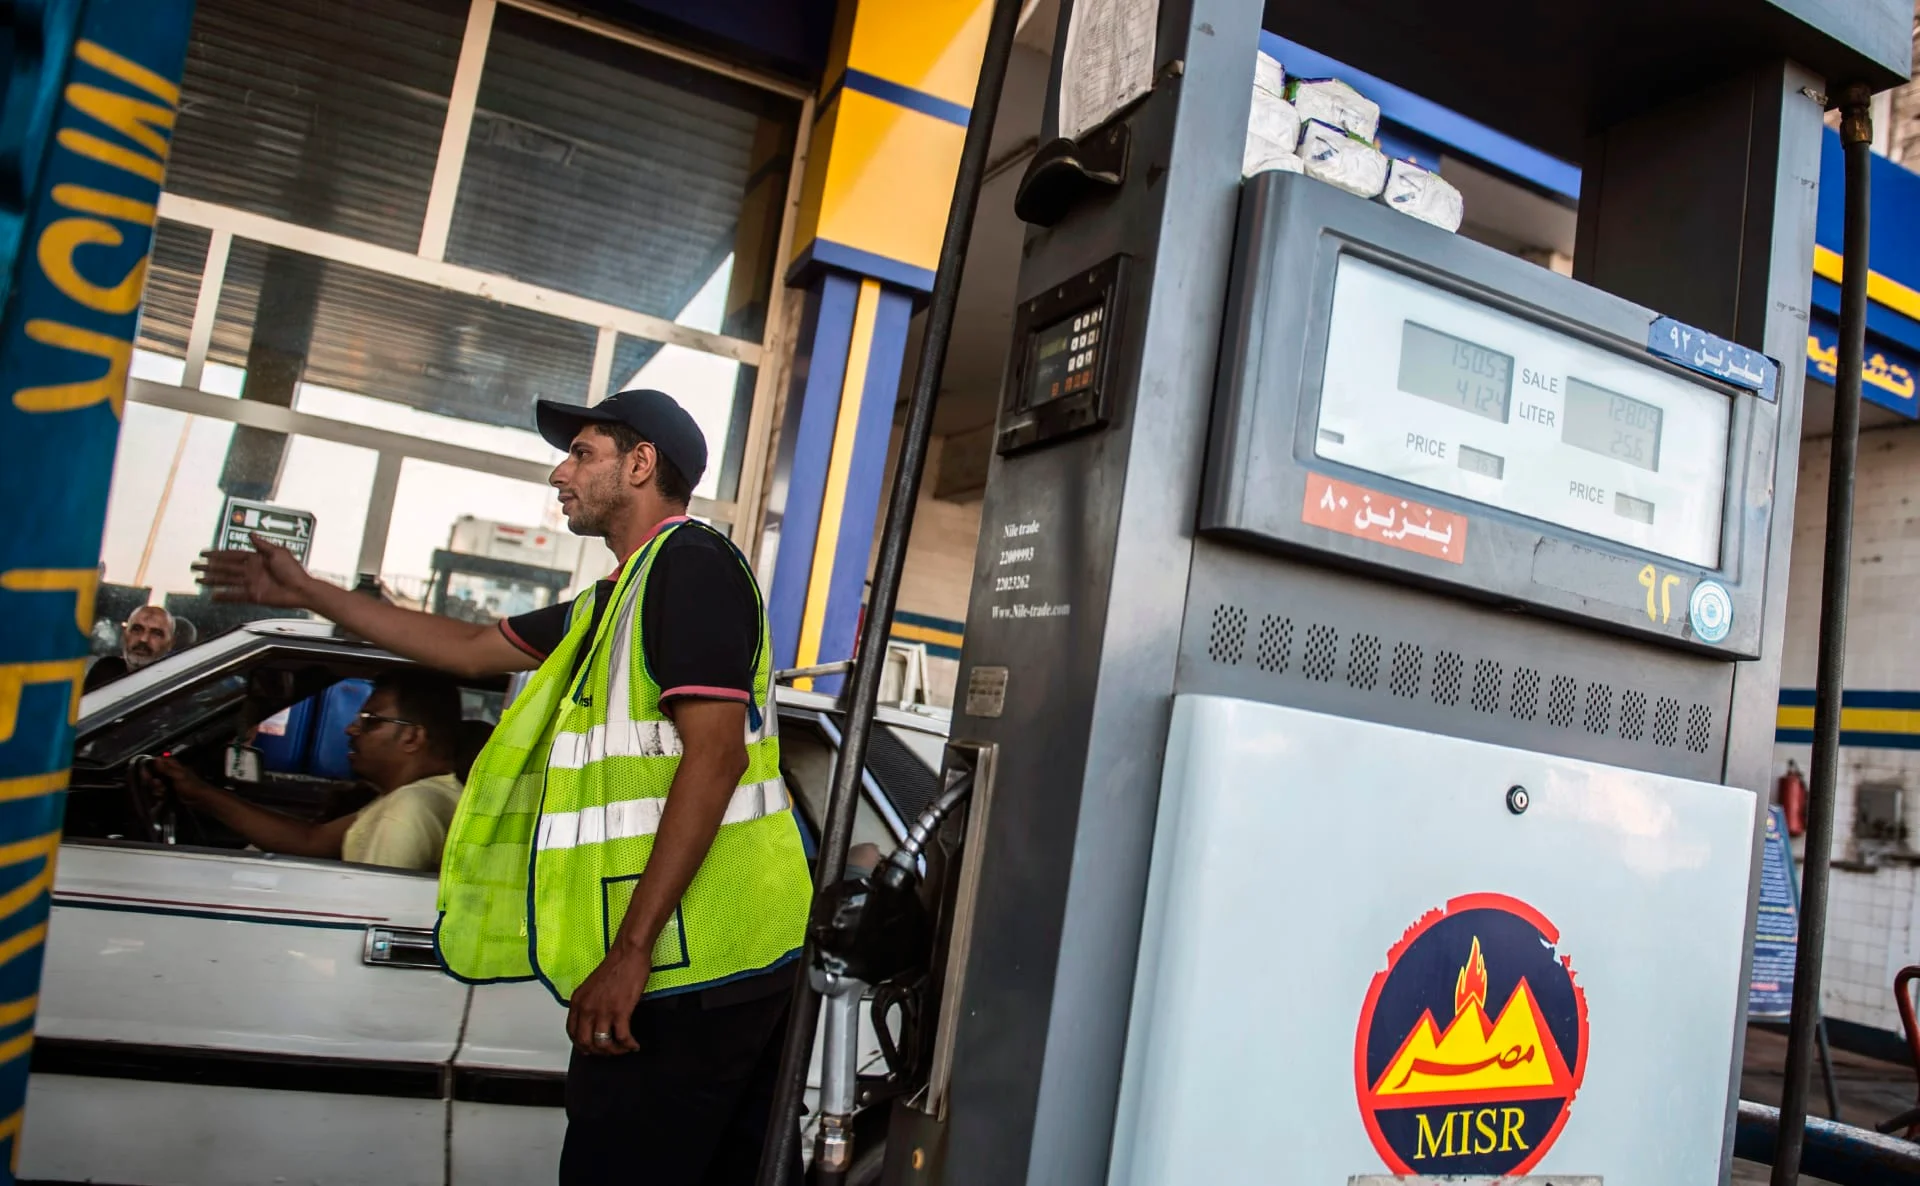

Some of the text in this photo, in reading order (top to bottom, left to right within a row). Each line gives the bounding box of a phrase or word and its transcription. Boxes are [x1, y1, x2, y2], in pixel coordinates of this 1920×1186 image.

[1521, 367, 1559, 394] SALE
[1519, 400, 1556, 428] LITER
[1405, 432, 1447, 459] PRICE
[1568, 480, 1605, 505] PRICE
[1003, 519, 1040, 538] Nile trade
[1320, 484, 1453, 554] بنزين ٨٠
[1392, 1043, 1536, 1090] مصر
[1412, 1106, 1530, 1160] MISR
